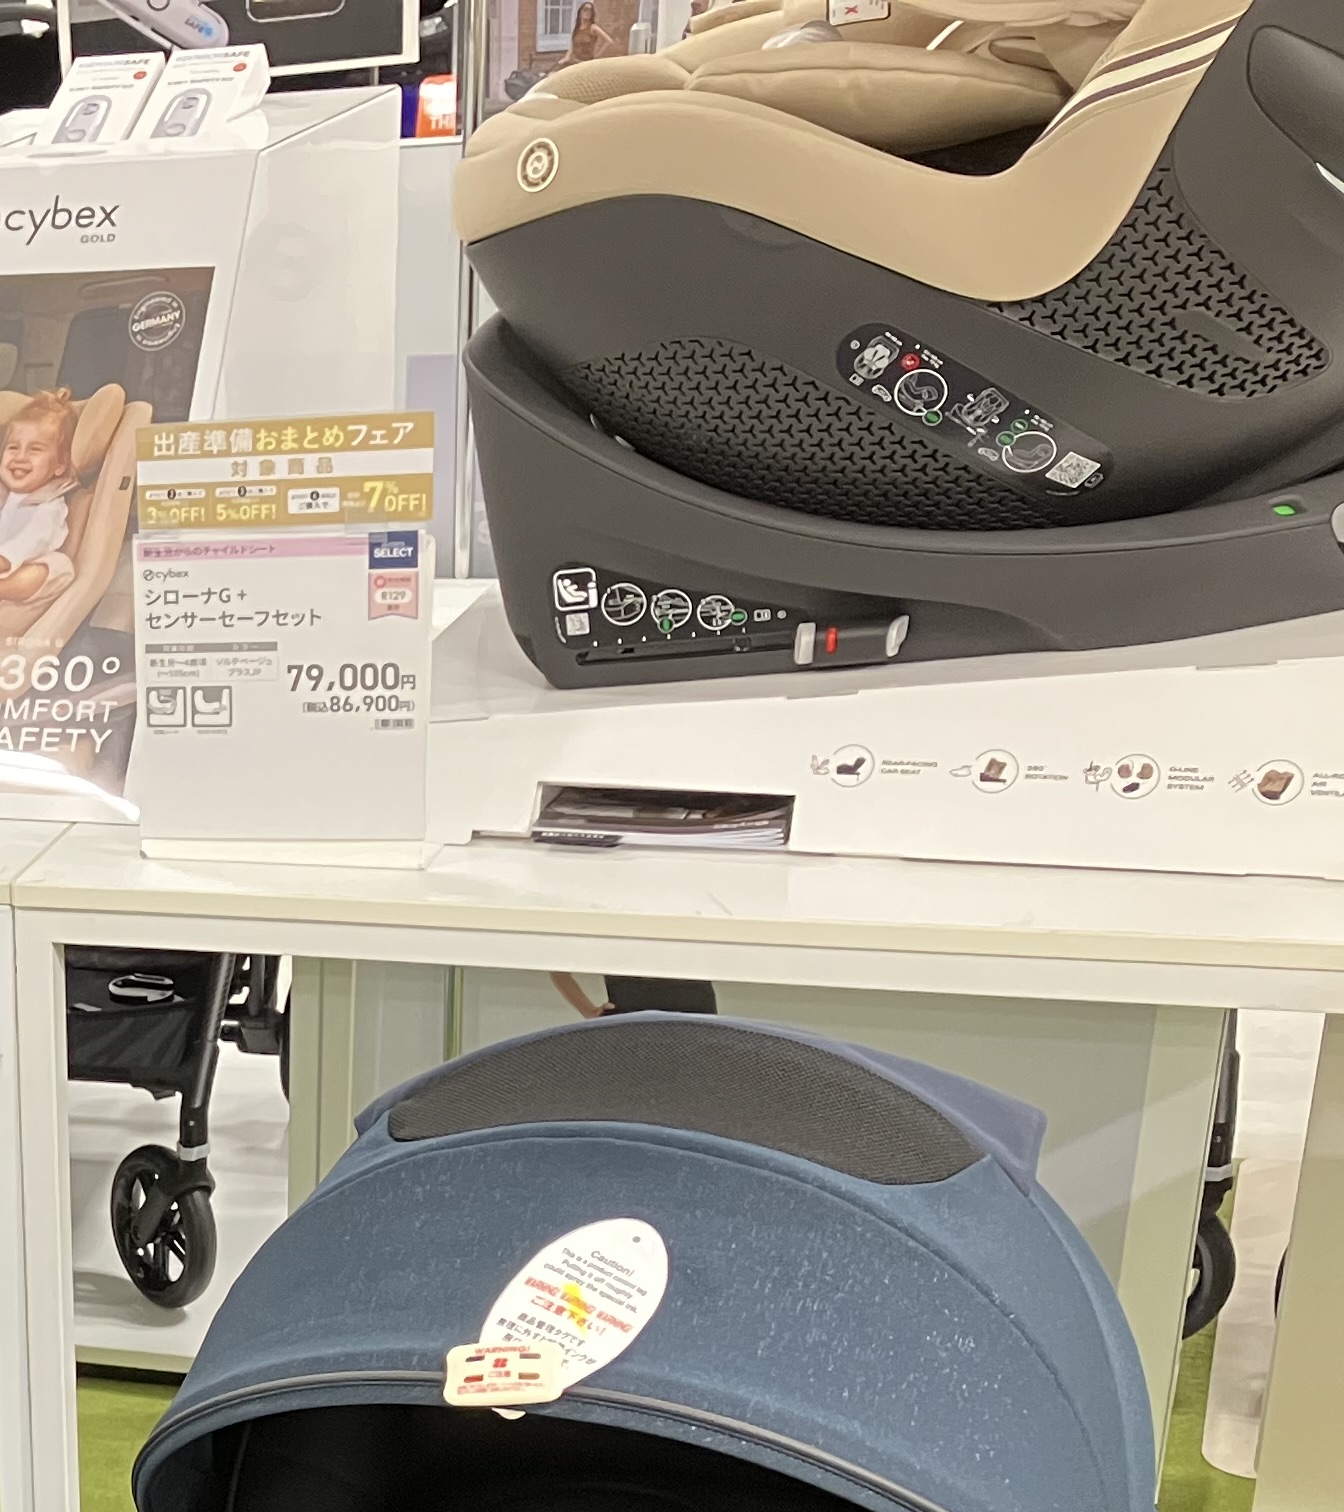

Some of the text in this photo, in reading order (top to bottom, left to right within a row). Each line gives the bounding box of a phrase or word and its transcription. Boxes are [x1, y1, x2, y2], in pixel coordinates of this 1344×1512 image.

[4, 195, 120, 245] cybex
[80, 233, 116, 244] GOLD
[152, 422, 414, 457] 出産準備おまとめフェア
[373, 547, 414, 558] SELECT
[144, 587, 231, 606] シローナG
[145, 609, 322, 629] センサーセーフセット
[286, 662, 417, 692] 79,000円
[591, 1250, 636, 1278] Caution!
